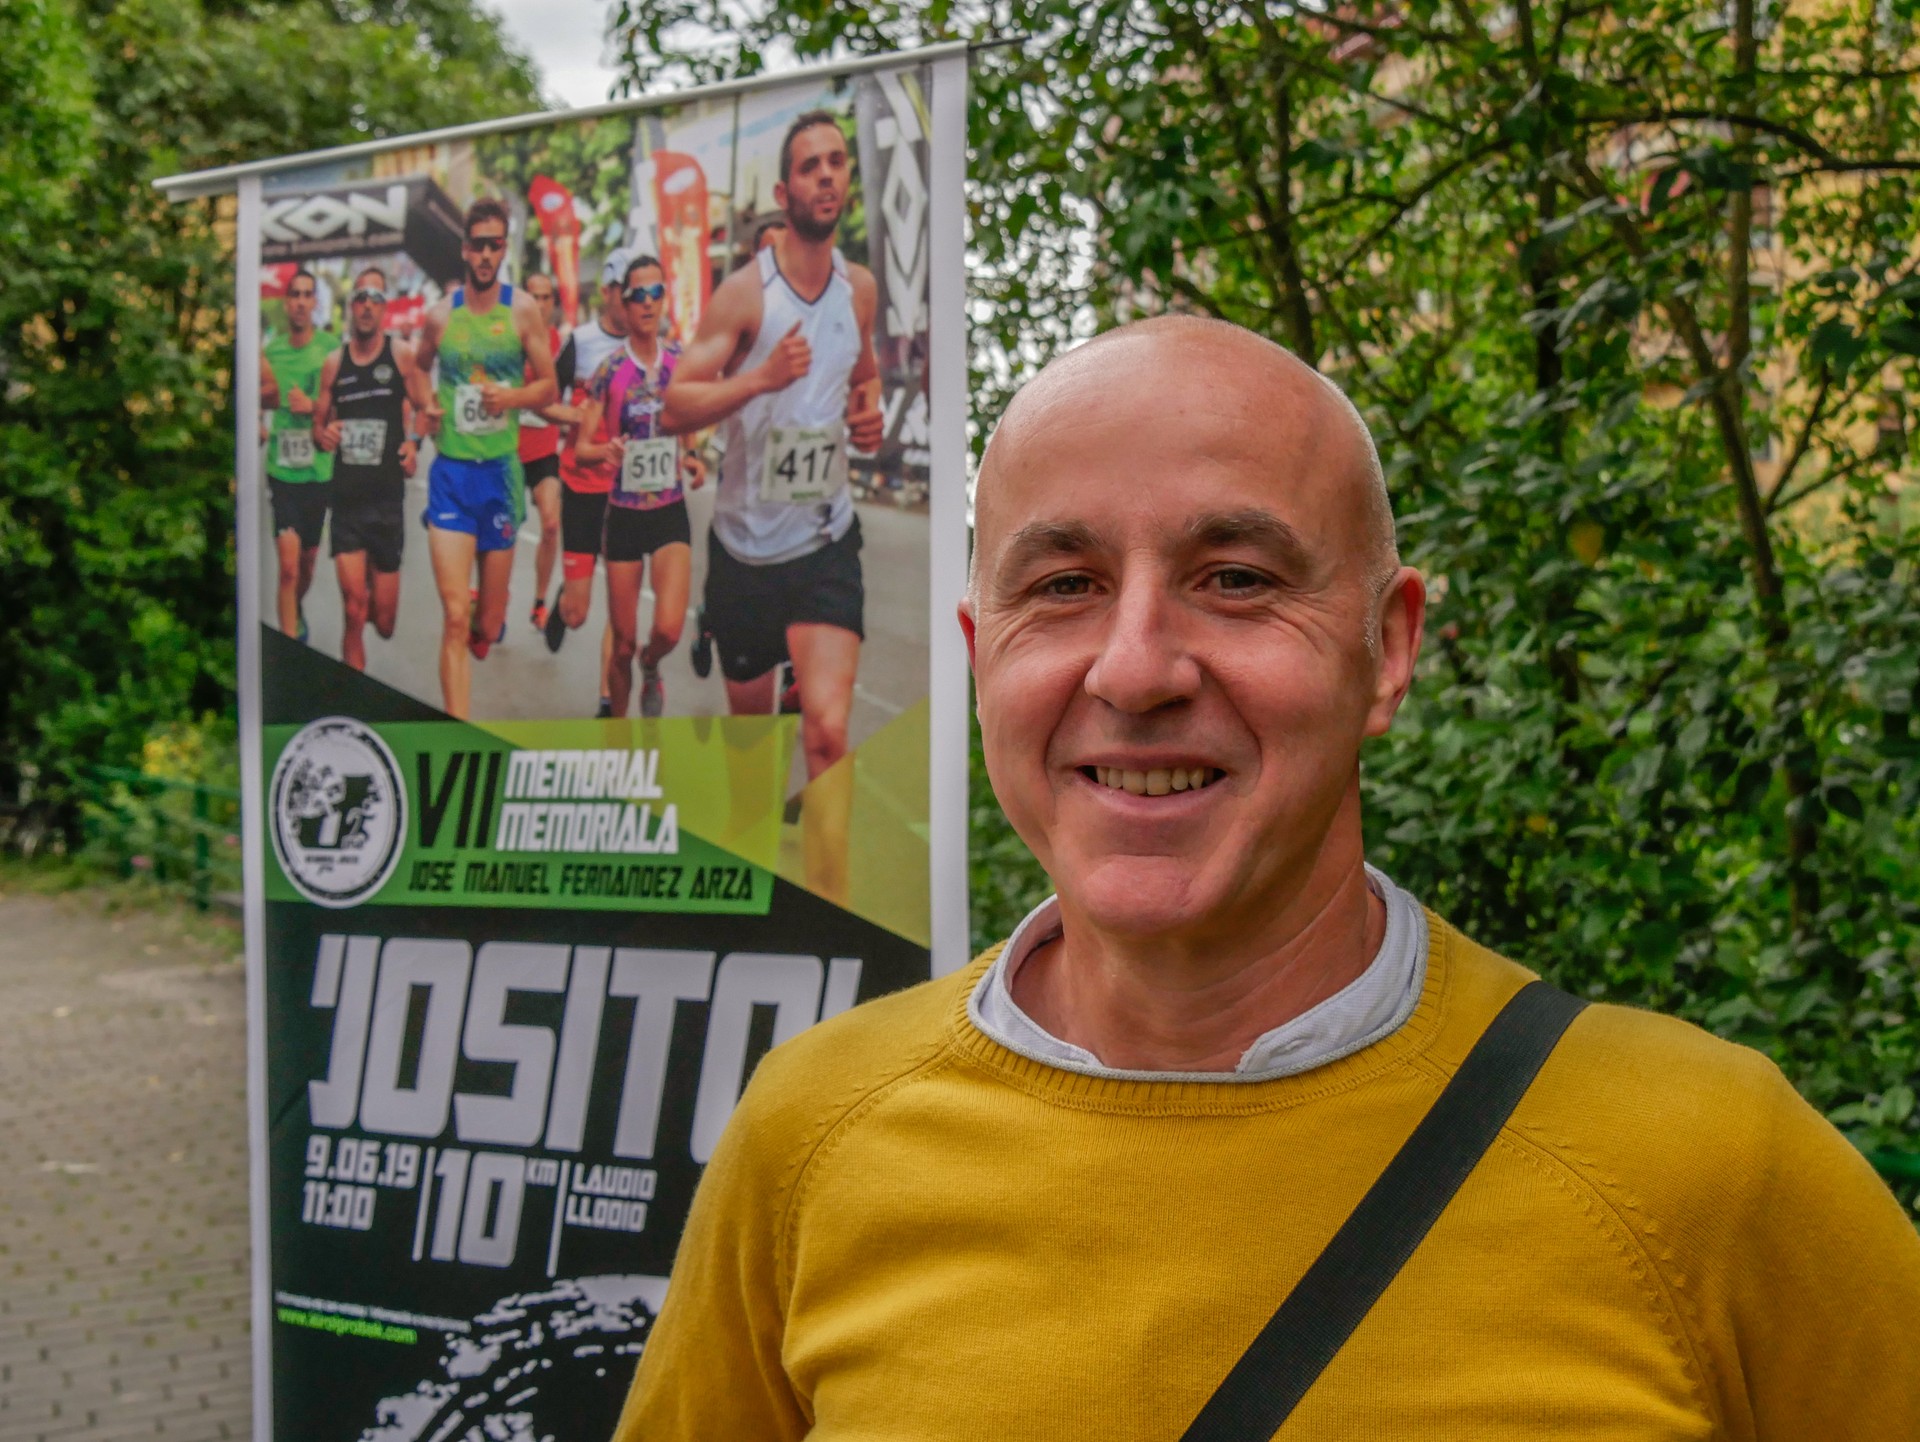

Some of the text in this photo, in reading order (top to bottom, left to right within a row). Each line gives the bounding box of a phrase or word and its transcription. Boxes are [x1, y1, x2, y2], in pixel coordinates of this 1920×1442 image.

[631, 452, 672, 478] 510
[776, 443, 836, 483] 417
[504, 749, 662, 799] MEMORIAL
[416, 752, 501, 848] VII
[496, 803, 679, 855] MEMORIALA
[408, 860, 753, 901] JOSE MANUEL FERNANDEZ ARZA
[305, 1134, 421, 1189] 9.06.19
[572, 1162, 658, 1200] LAUDIO
[302, 1180, 376, 1231] 11:00
[430, 1148, 526, 1269] 10
[565, 1194, 648, 1233] LLODIO
